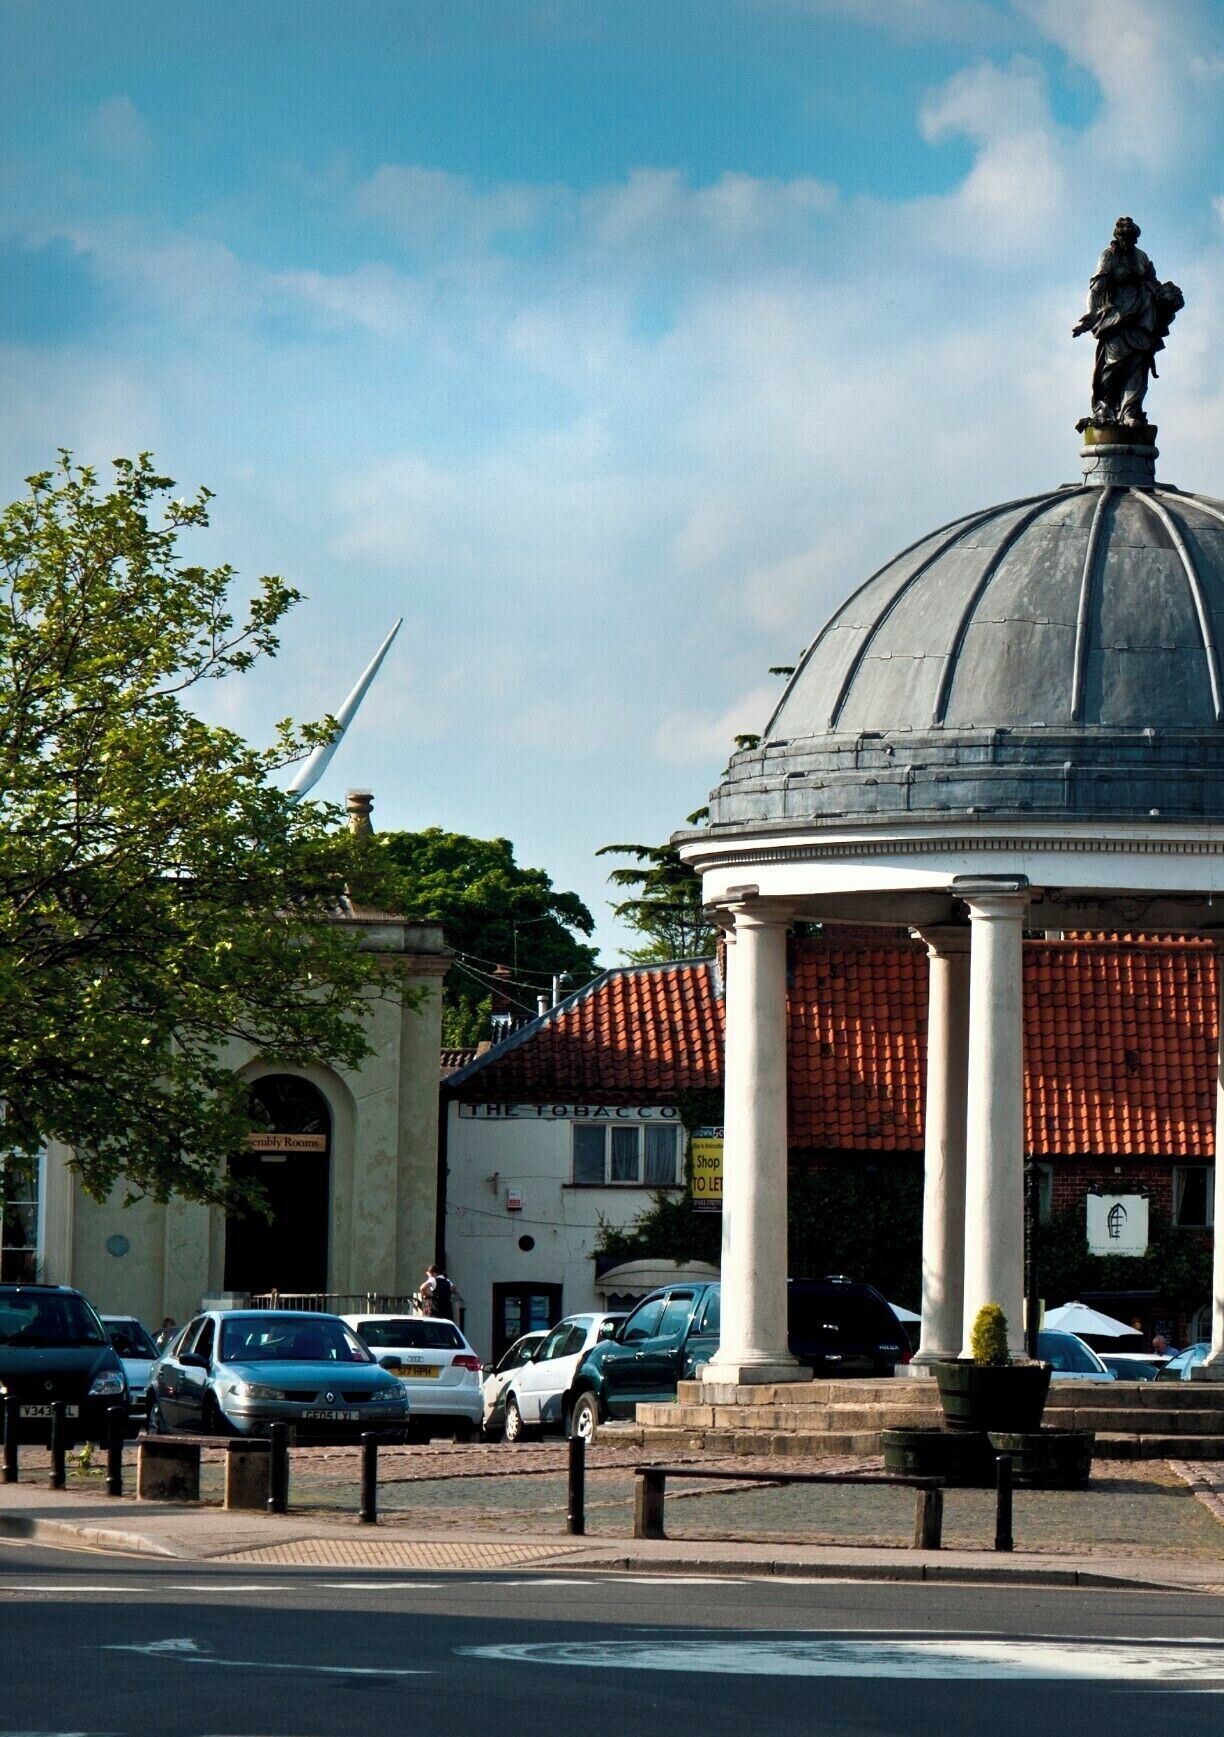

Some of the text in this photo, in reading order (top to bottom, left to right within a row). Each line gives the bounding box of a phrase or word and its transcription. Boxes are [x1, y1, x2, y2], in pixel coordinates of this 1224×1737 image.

[466, 1103, 677, 1118] THE TOBACCO
[284, 1136, 320, 1148] Rooms
[697, 1155, 720, 1171] Shop
[693, 1177, 723, 1191] TO LET
